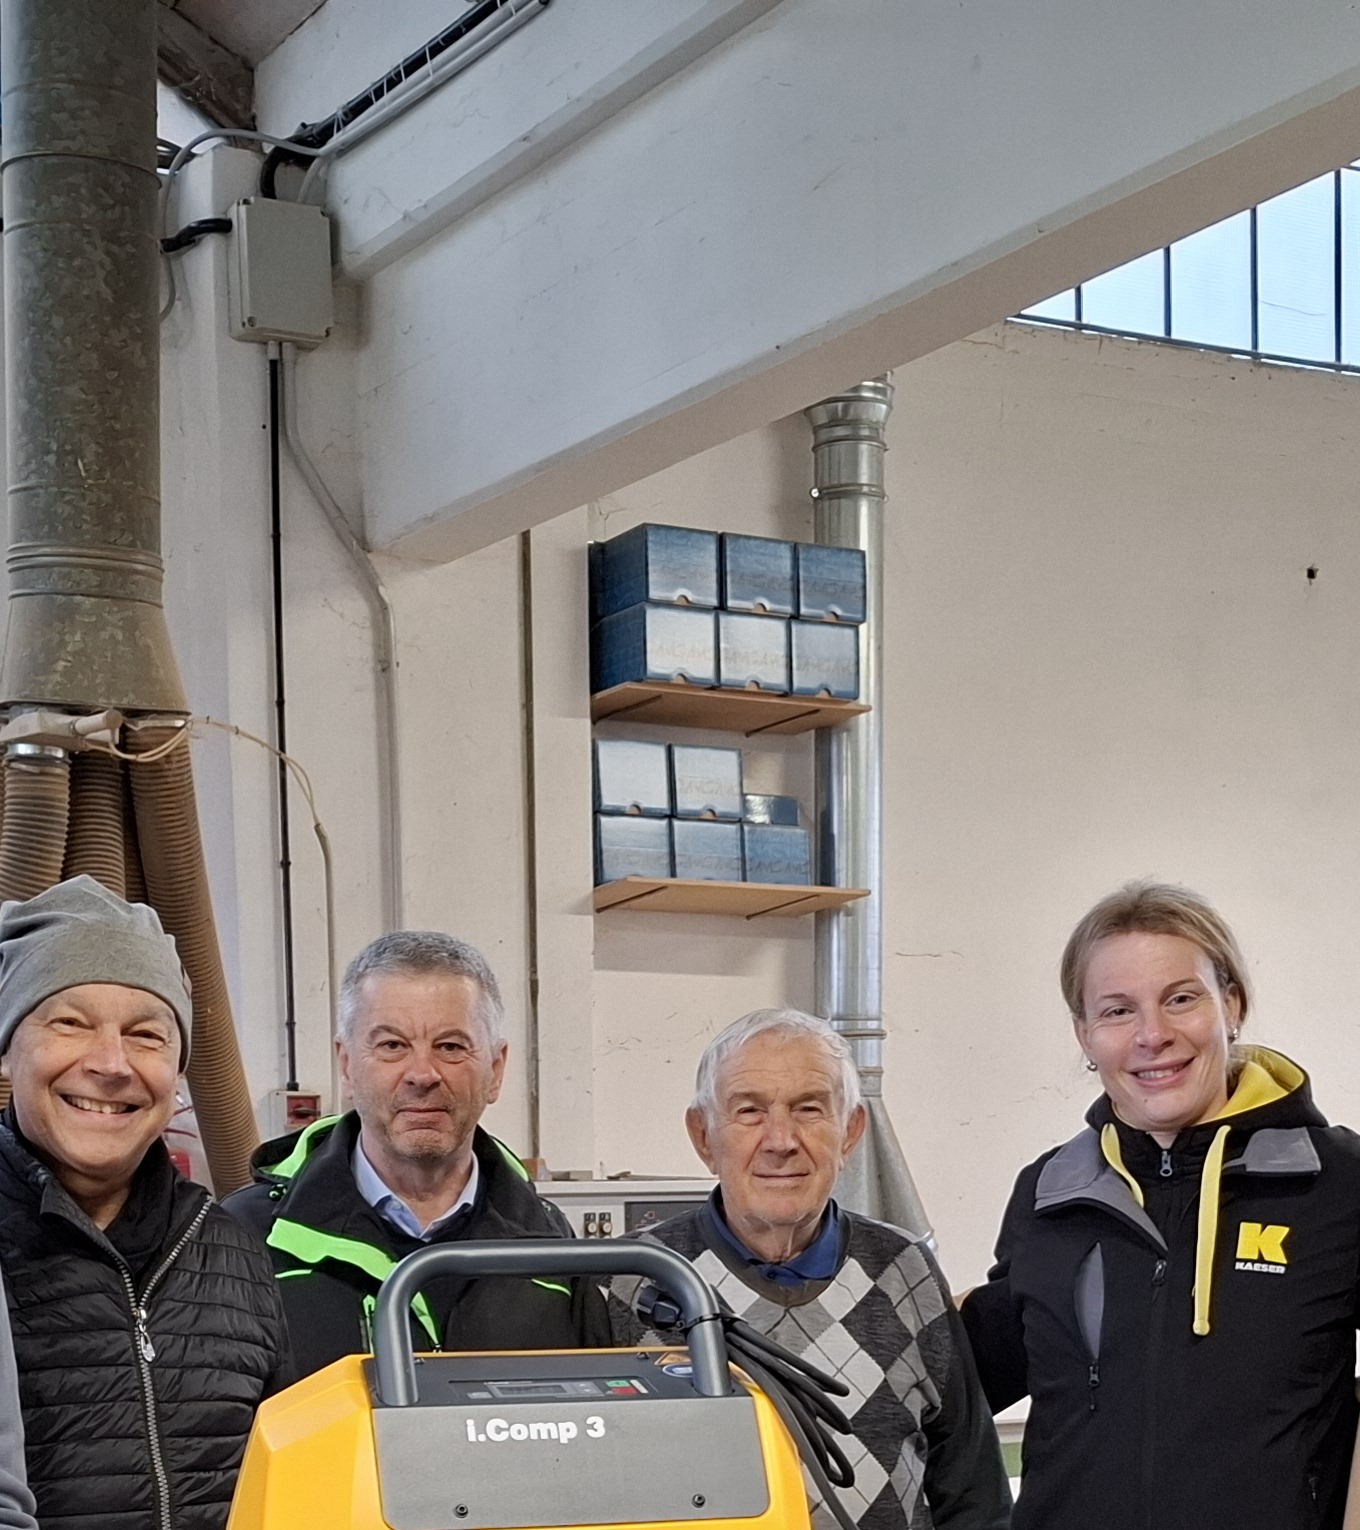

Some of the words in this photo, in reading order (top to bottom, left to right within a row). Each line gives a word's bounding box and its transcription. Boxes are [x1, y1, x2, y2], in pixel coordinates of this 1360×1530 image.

[1236, 1222, 1290, 1264] K
[465, 1418, 578, 1443] i.Comp
[586, 1416, 606, 1439] 3
